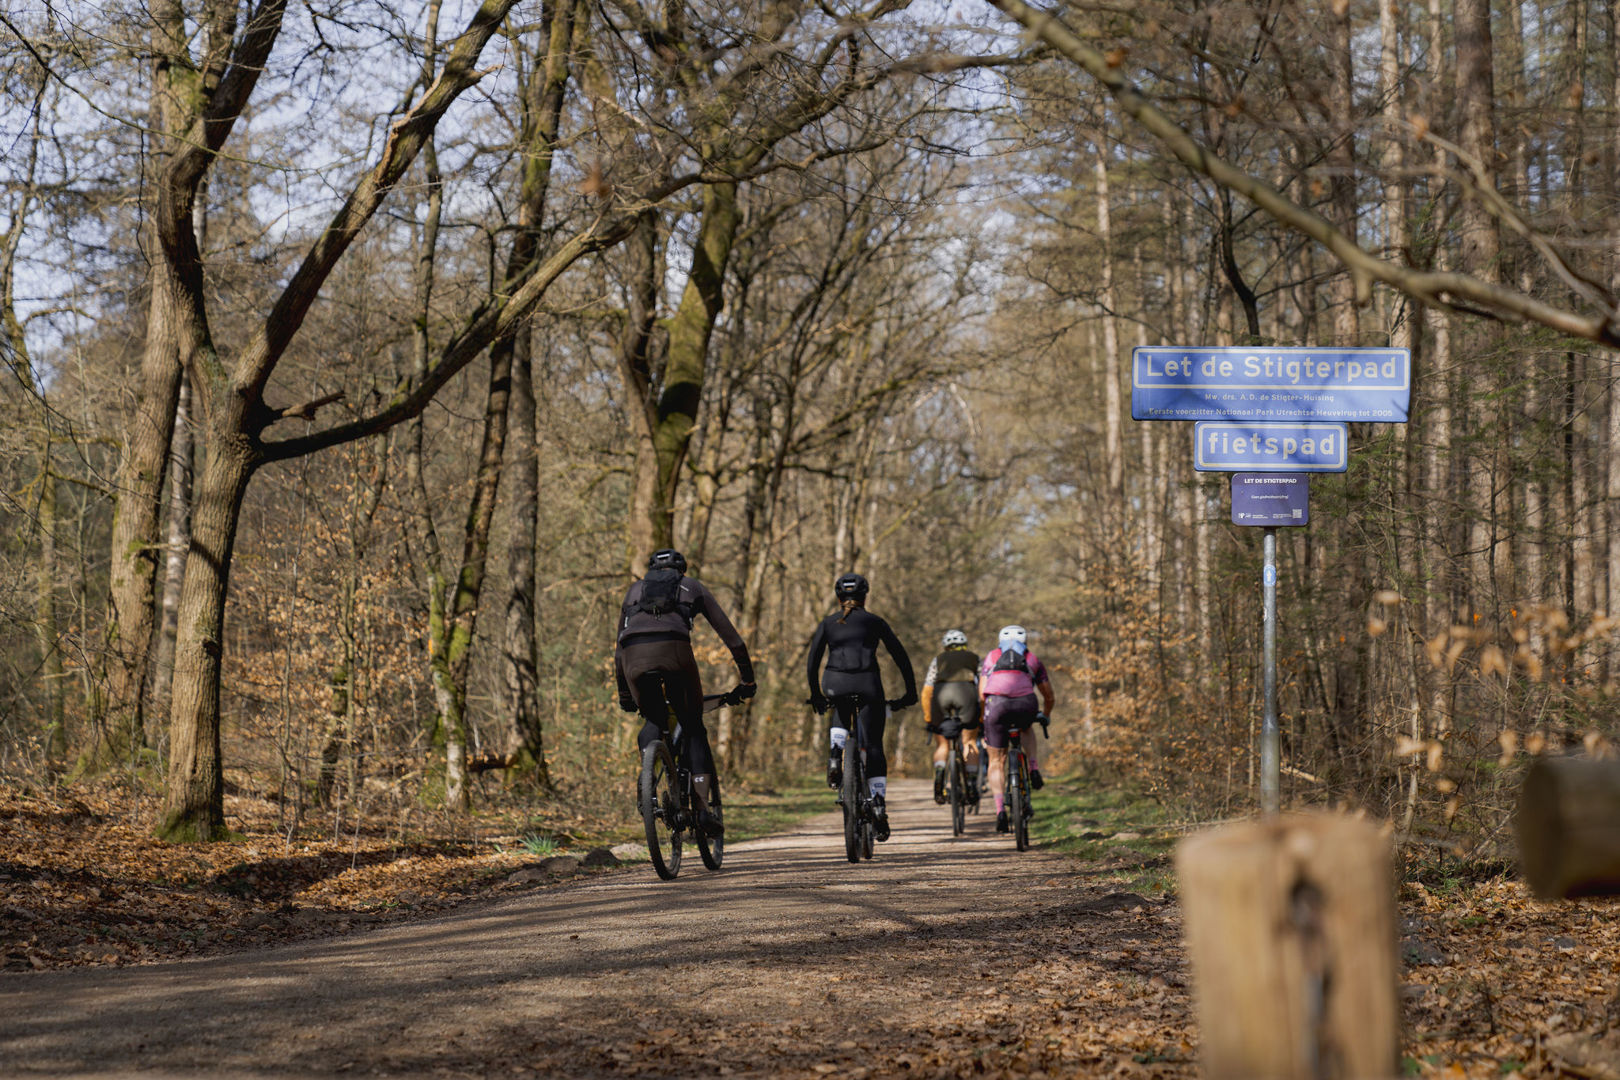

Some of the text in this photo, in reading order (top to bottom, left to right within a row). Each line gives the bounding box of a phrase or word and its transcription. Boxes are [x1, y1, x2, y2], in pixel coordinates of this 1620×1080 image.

[1147, 355, 1396, 384] Let de Stigterpad
[1260, 393, 1269, 401] de
[1216, 408, 1254, 416] Nationaal
[1316, 409, 1357, 417] Heuvelrug
[1359, 409, 1370, 417] tot
[1208, 432, 1335, 460] fietspad
